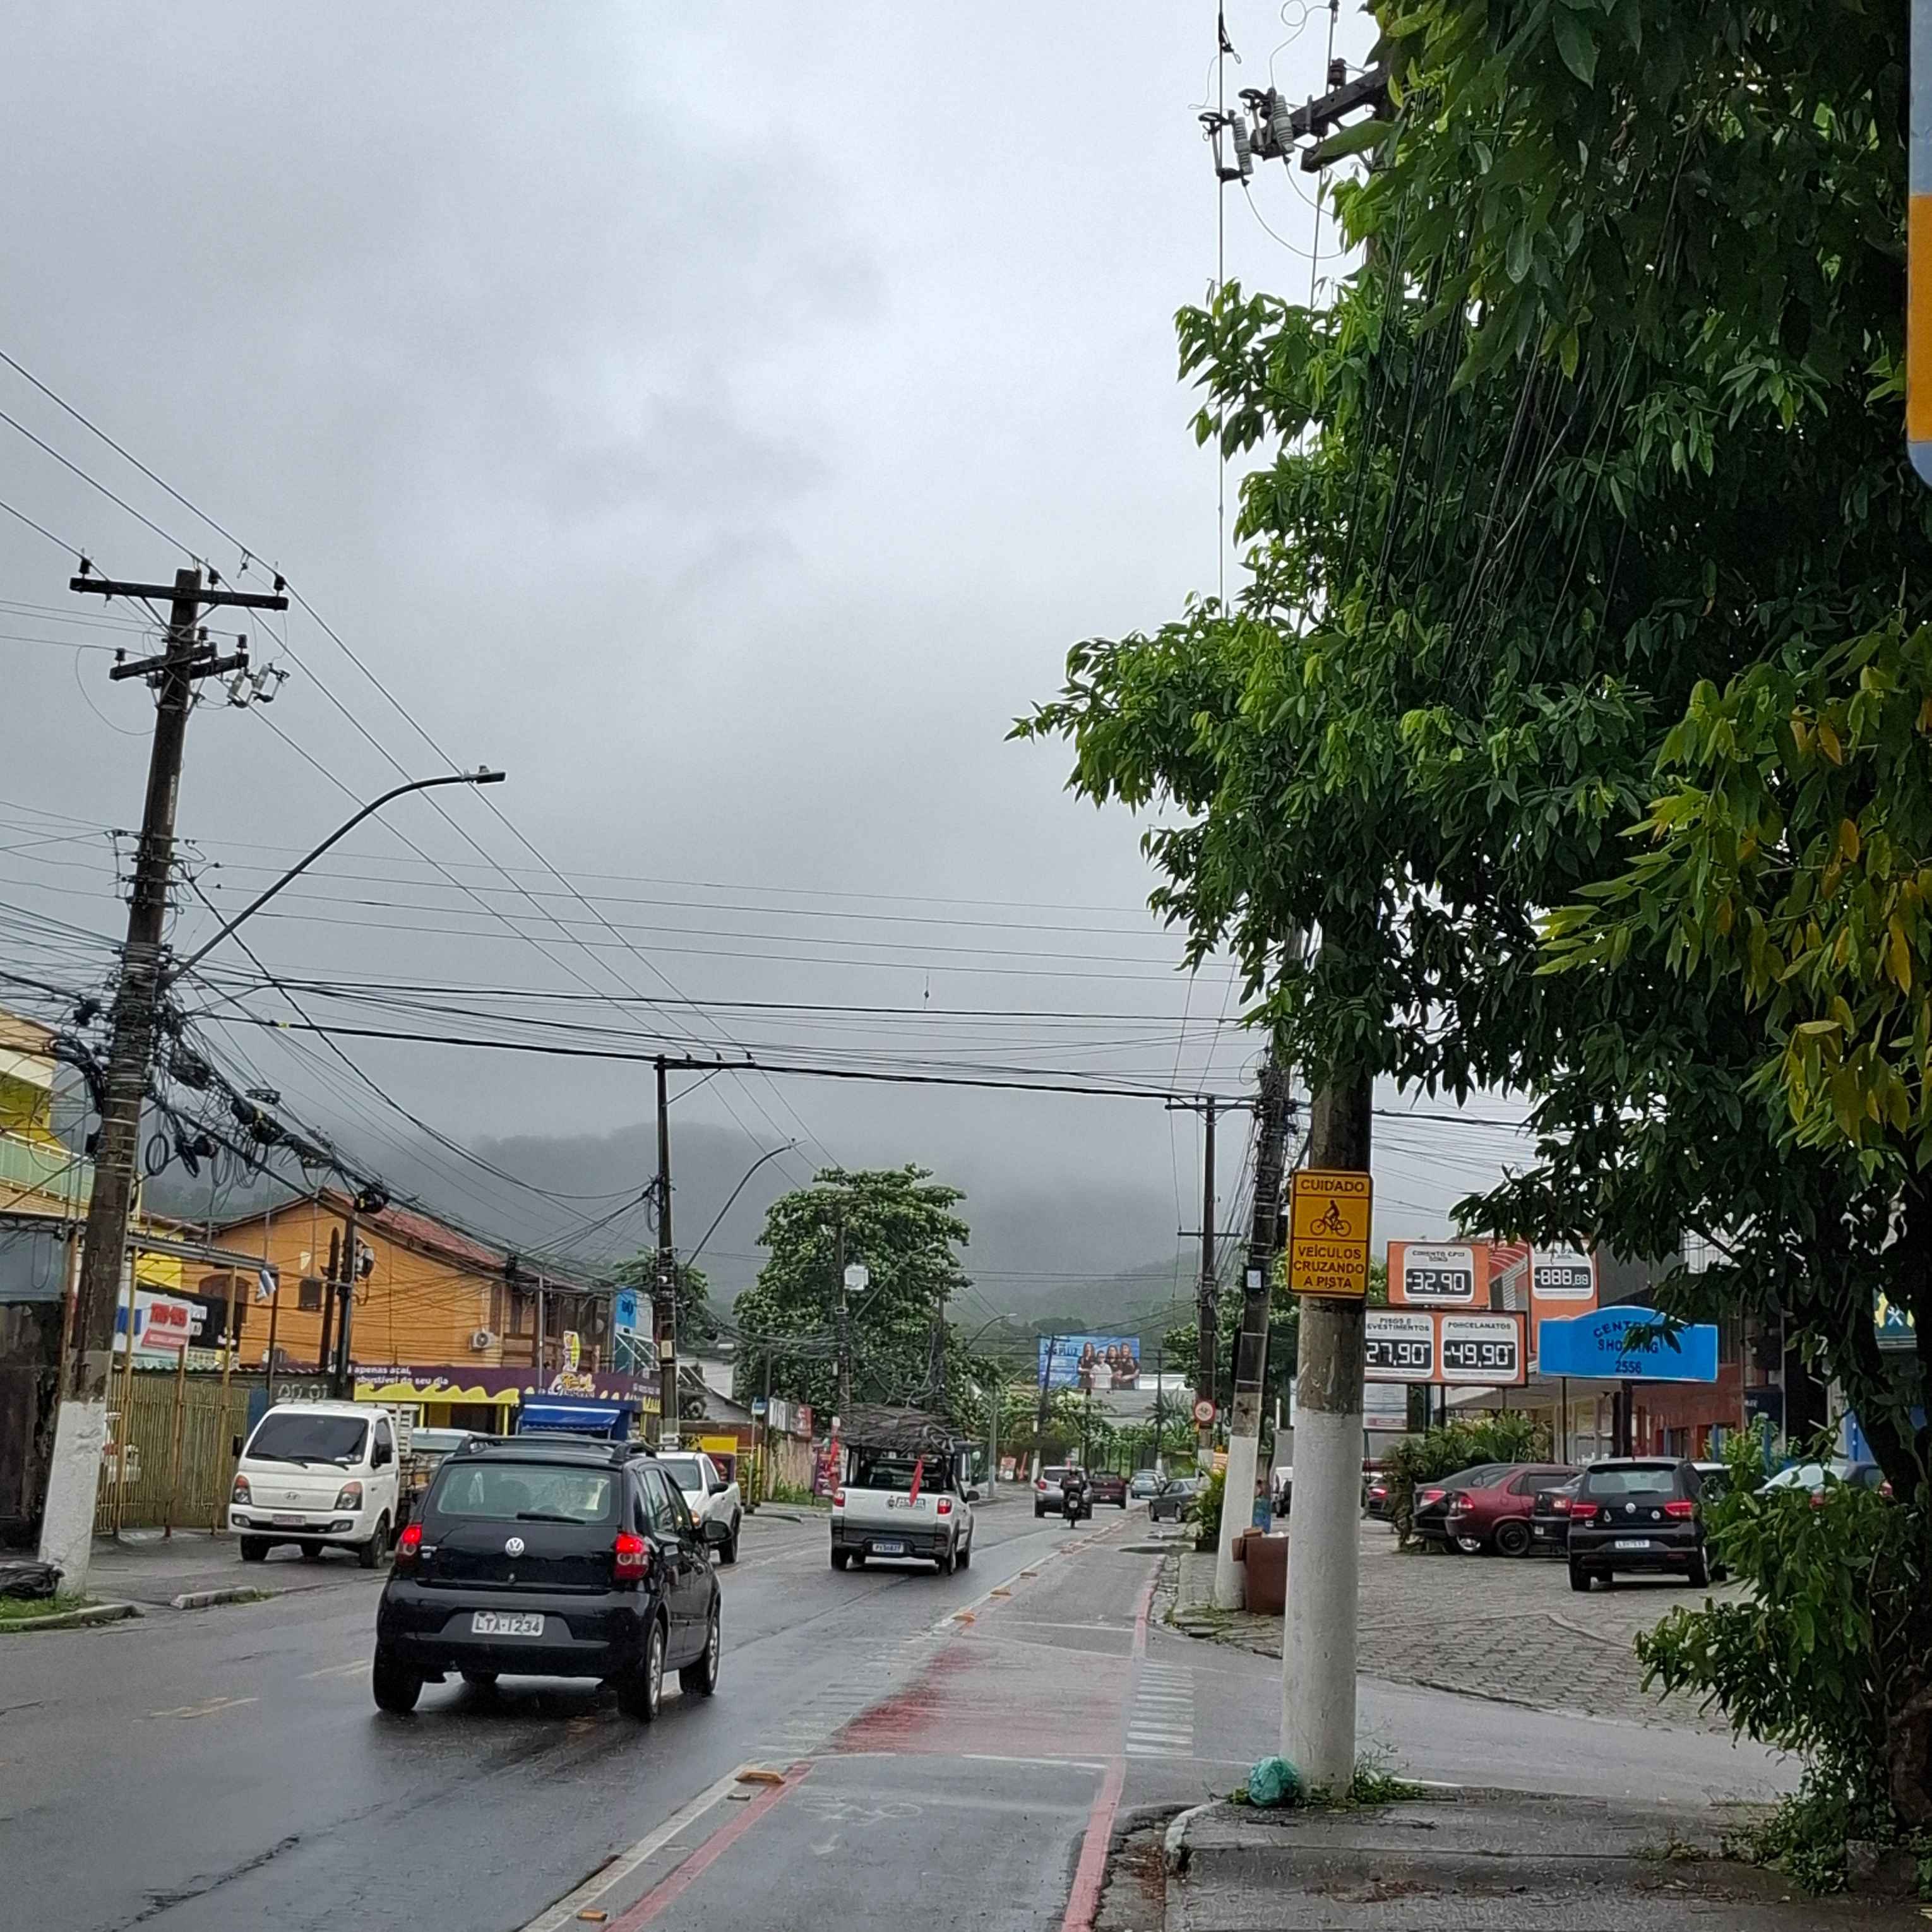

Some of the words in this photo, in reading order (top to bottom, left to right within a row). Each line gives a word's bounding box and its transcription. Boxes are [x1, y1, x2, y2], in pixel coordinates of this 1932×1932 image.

[1301, 1179, 1365, 1192] CUIDADO
[1298, 1244, 1362, 1260] VEÍCULOS
[1294, 1261, 1365, 1274] CRUZANDO
[1304, 1276, 1313, 1287] A
[1317, 1276, 1353, 1289] PISTA
[1598, 1339, 1659, 1354] SHOING
